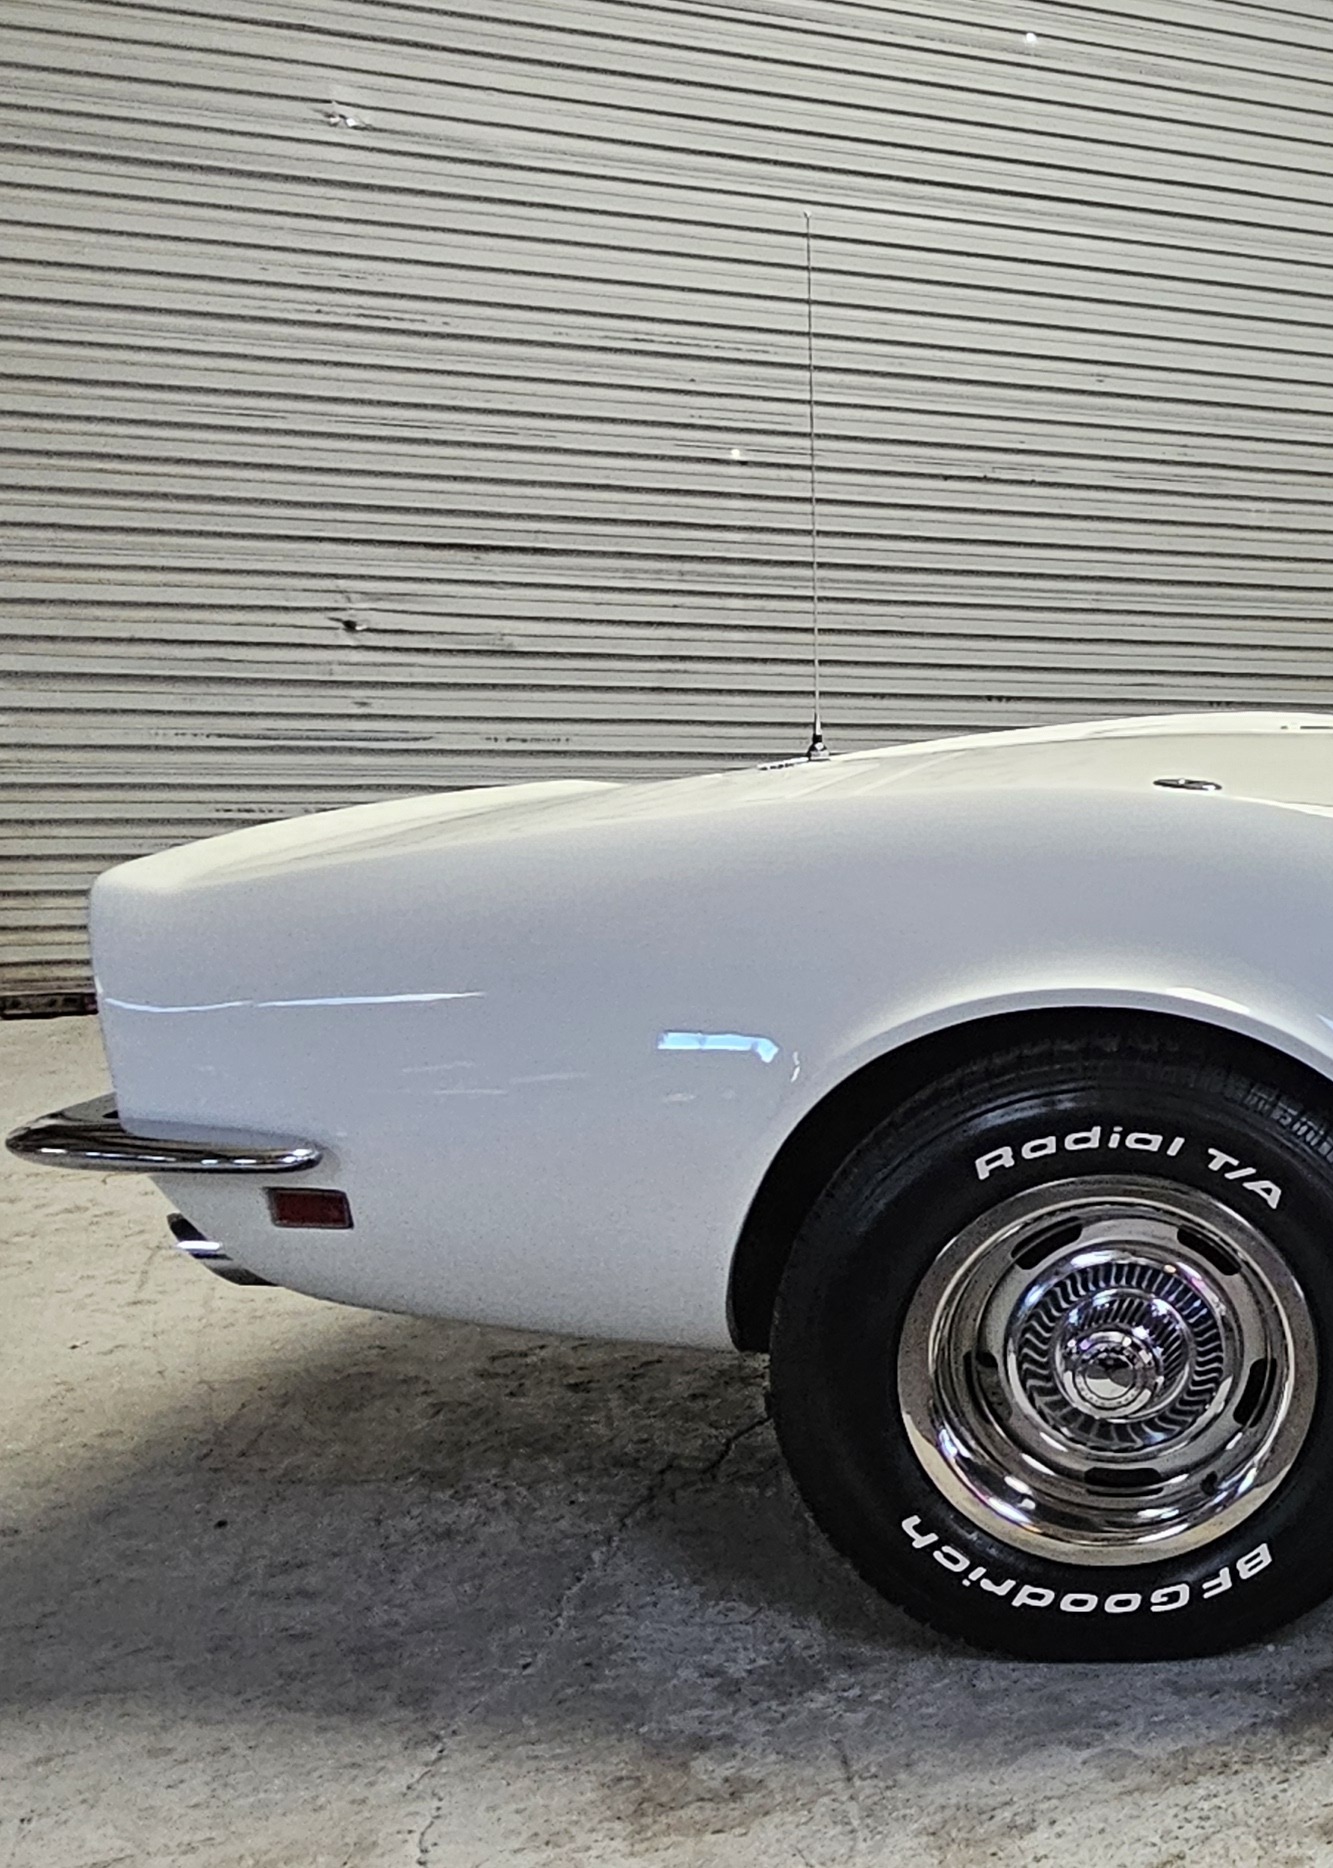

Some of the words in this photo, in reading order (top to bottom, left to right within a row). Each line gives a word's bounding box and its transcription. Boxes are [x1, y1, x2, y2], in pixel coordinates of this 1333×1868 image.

[974, 1125, 1185, 1181] Radial
[1207, 1147, 1282, 1209] T/A
[900, 1514, 1274, 1614] BFGoodrich
